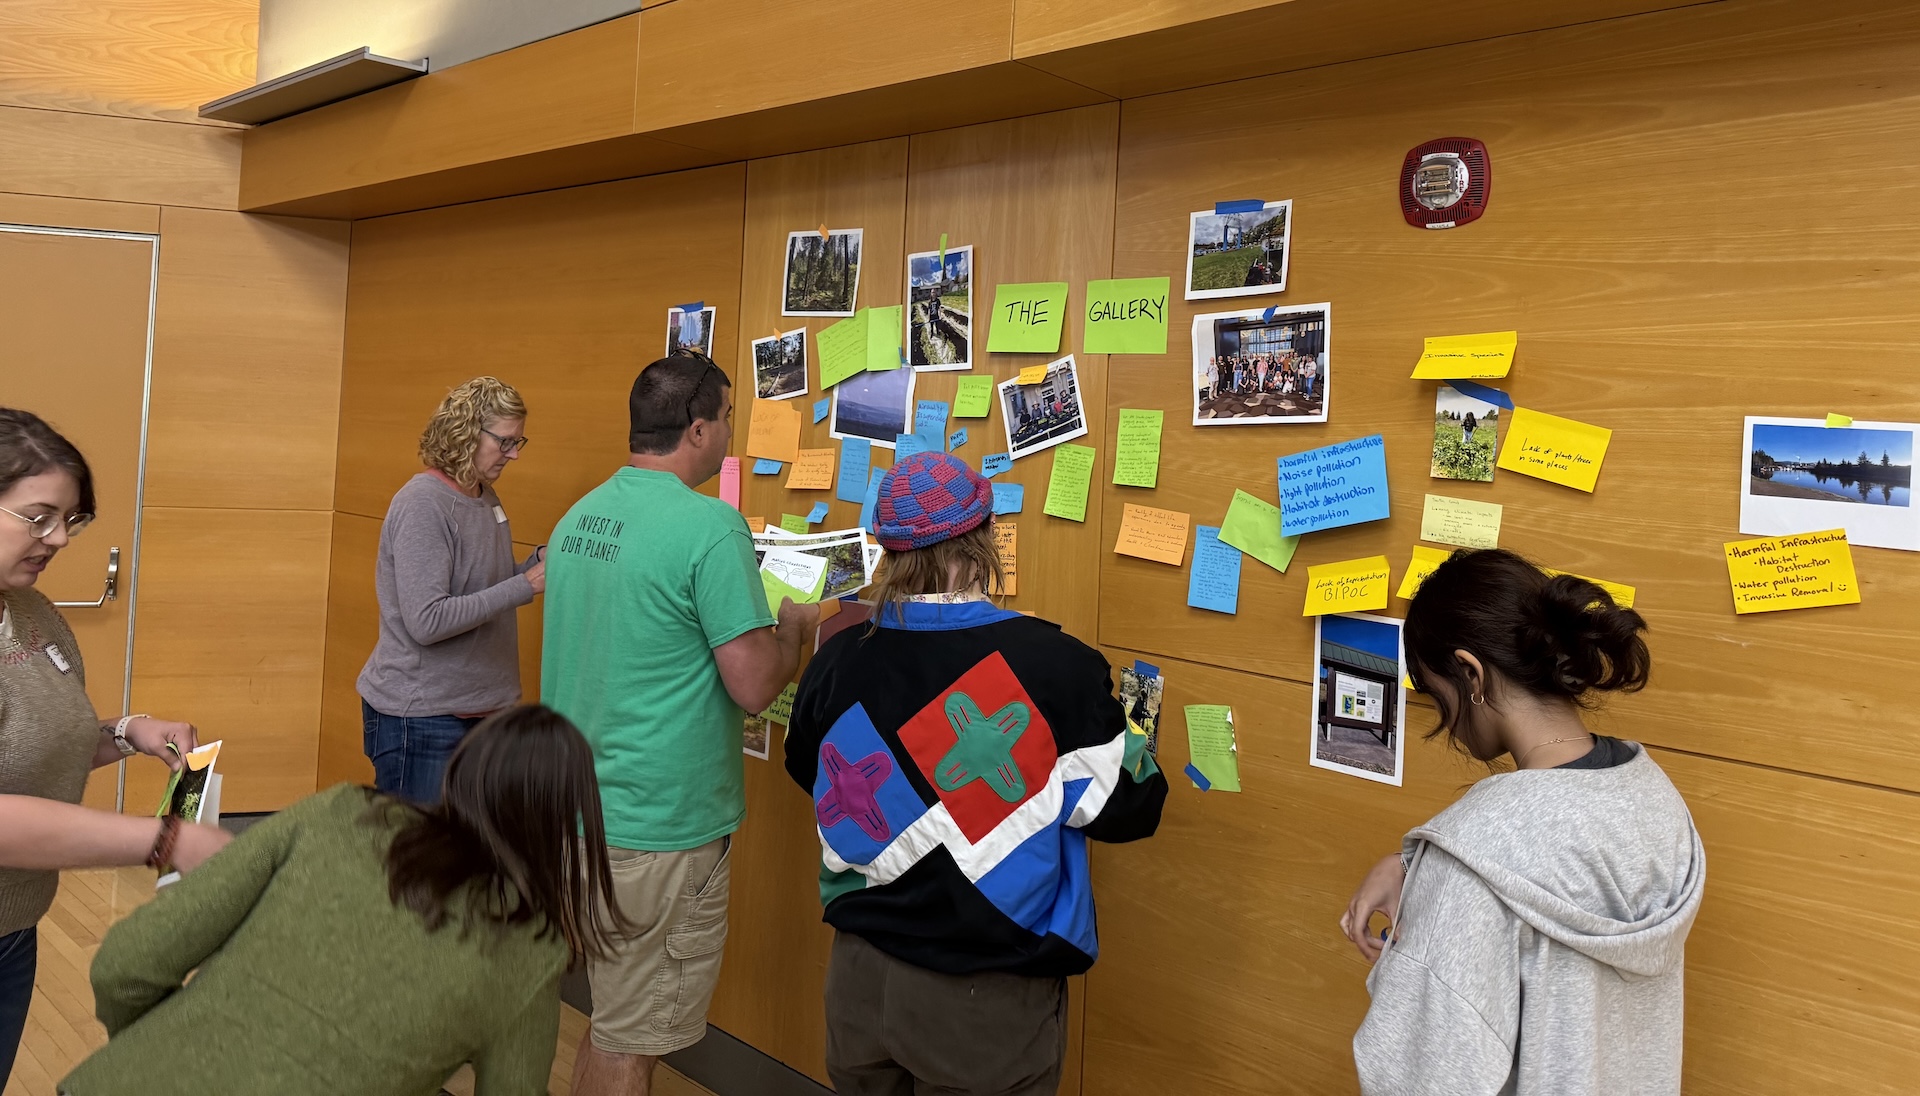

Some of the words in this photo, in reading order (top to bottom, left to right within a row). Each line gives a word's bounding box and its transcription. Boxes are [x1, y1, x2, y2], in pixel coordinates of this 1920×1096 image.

[1005, 299, 1049, 325] THE
[1089, 295, 1165, 324] GALLERY
[1522, 438, 1540, 452] Lack
[1283, 468, 1313, 482] Noise
[1316, 456, 1361, 478] pollution
[1529, 456, 1544, 465] some
[1546, 460, 1568, 471] places
[1304, 476, 1346, 497] pollution
[1284, 496, 1320, 515] Habitat
[1322, 486, 1375, 507] destruction
[576, 514, 611, 535] INVEST
[610, 520, 624, 539] IN
[1285, 516, 1308, 528] water
[1310, 508, 1350, 527] pollution
[561, 535, 583, 555] OUR
[584, 539, 621, 563] PLANET!
[1732, 542, 1776, 558] Harmful
[1759, 552, 1799, 567] Habitat
[1776, 558, 1831, 573] Destruction
[1315, 578, 1333, 589] Lack
[1739, 581, 1769, 589] Water
[1772, 574, 1817, 591] pollution
[1743, 591, 1787, 602] Invasive
[1791, 581, 1834, 598] Removal
